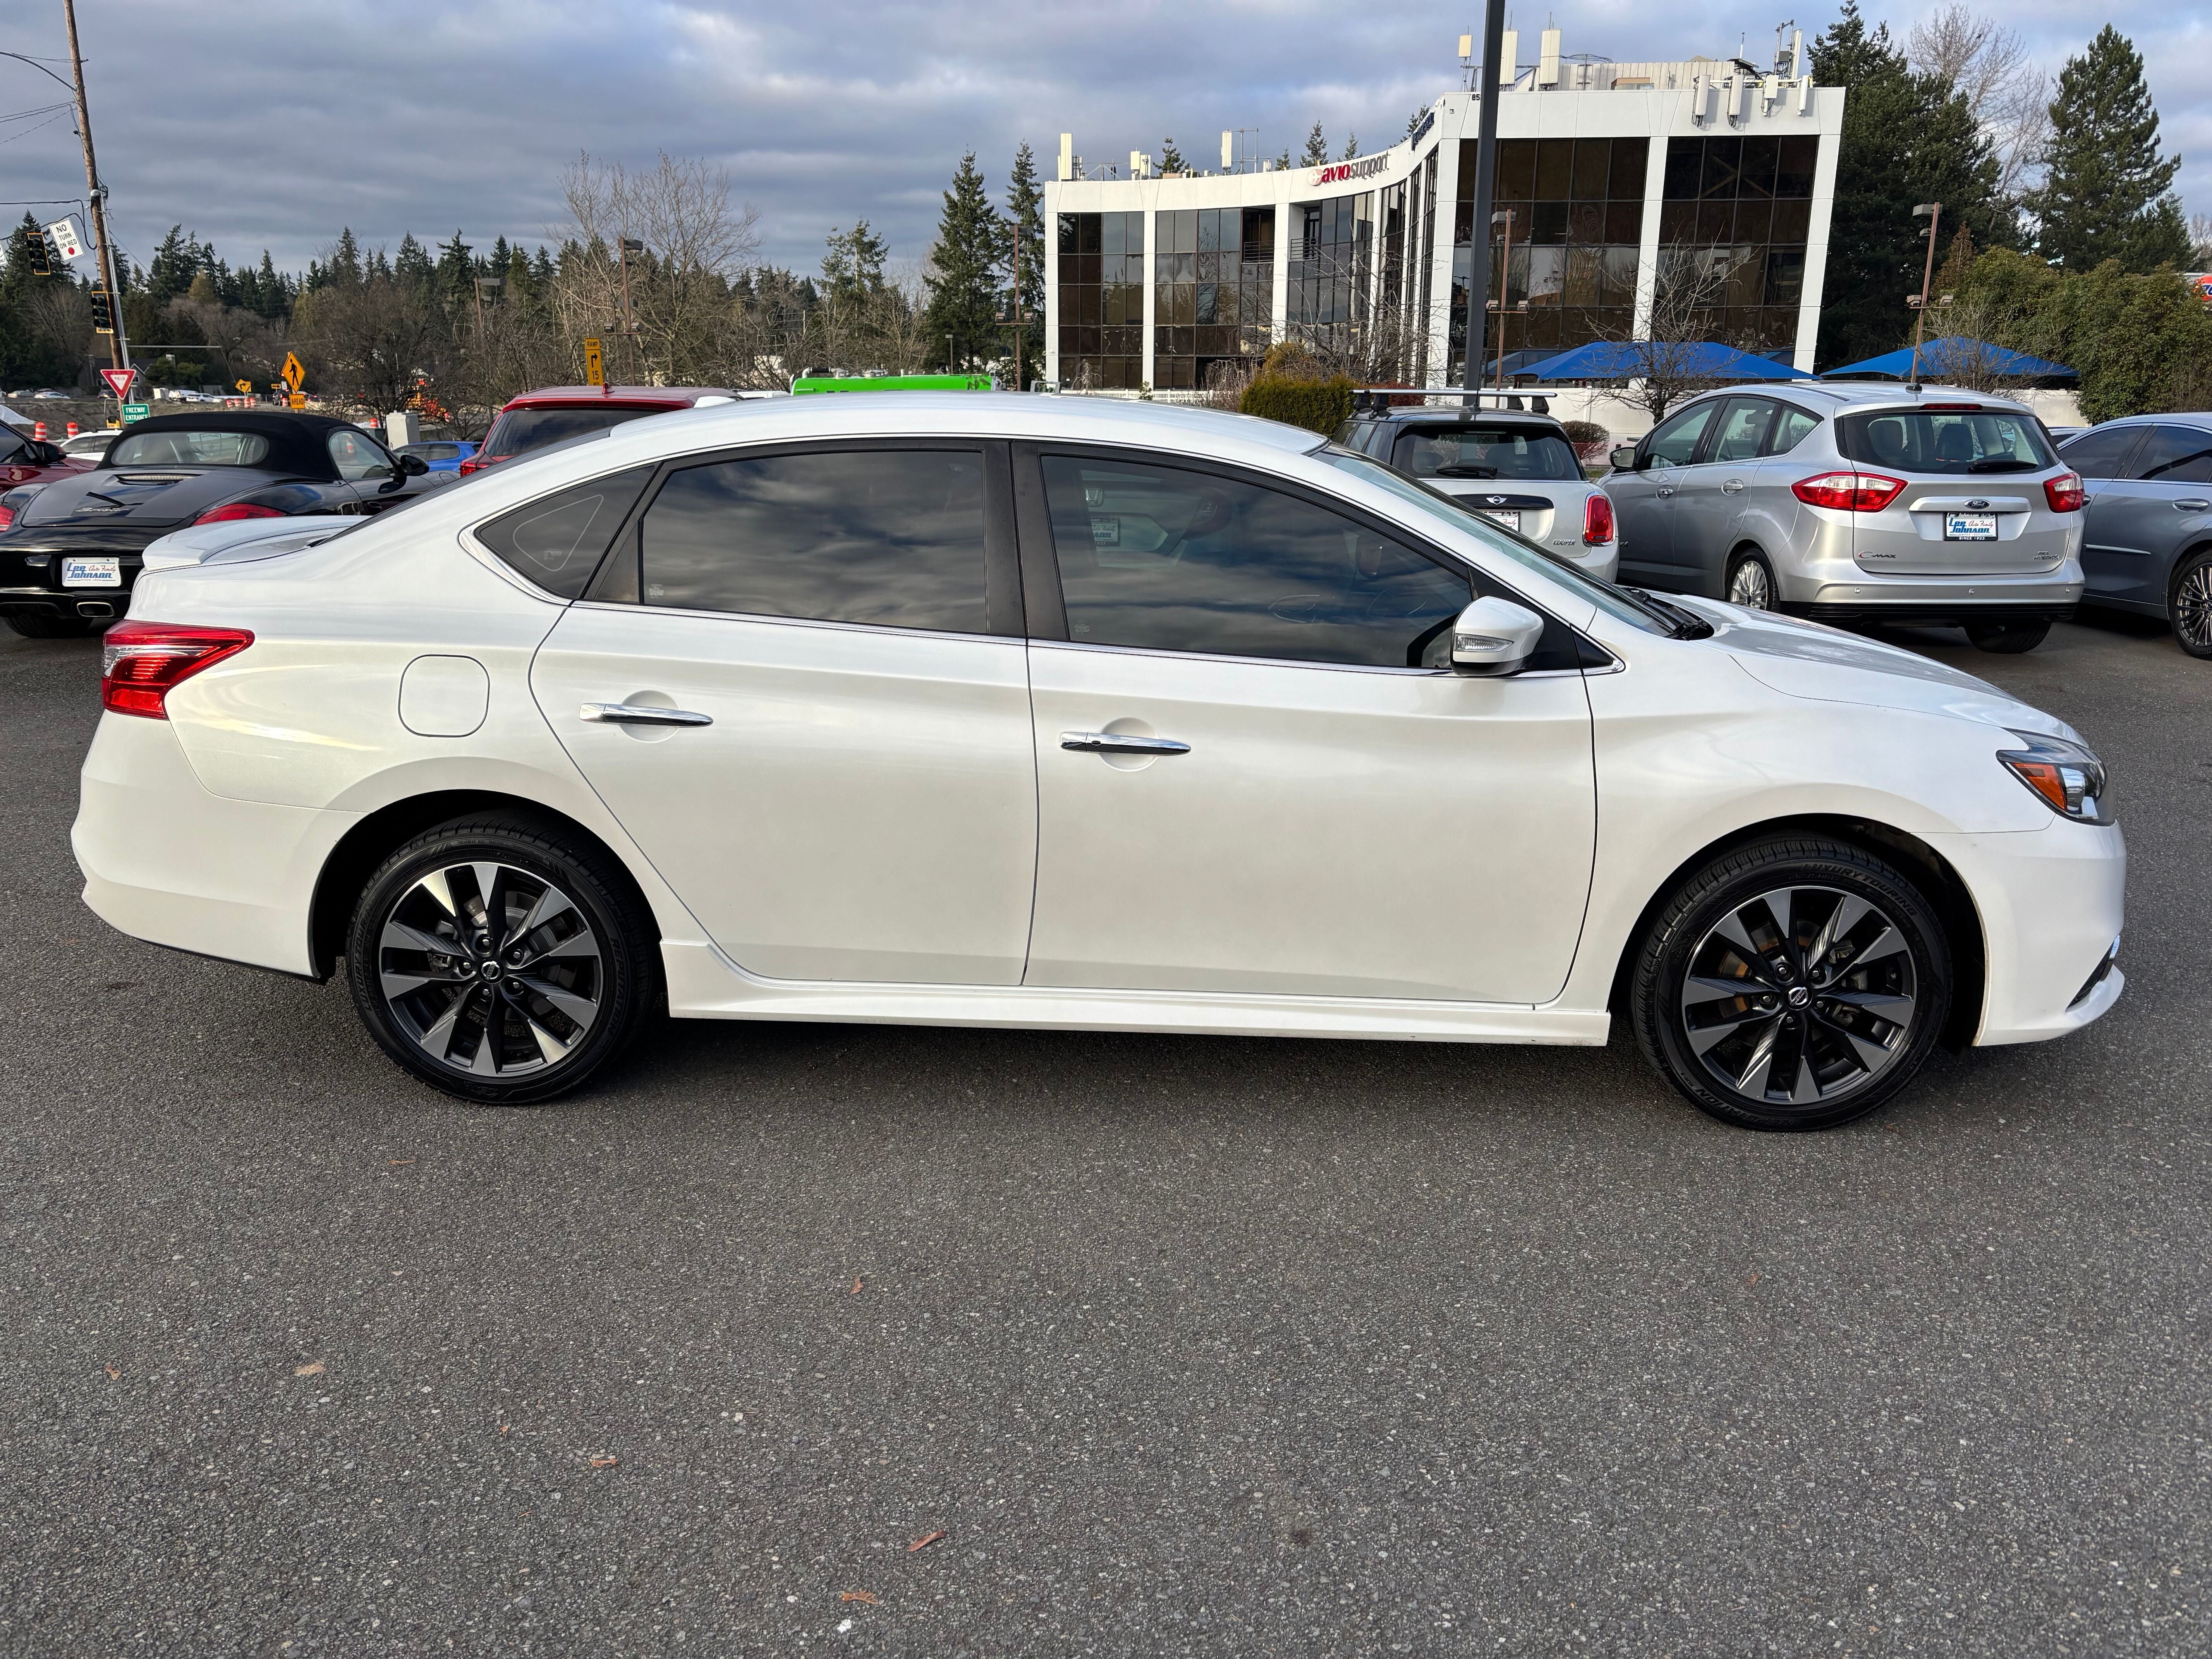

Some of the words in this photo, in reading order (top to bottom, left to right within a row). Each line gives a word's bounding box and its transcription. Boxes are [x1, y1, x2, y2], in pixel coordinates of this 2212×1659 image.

[1321, 151, 1390, 183] aviosupport
[56, 224, 67, 233] NO
[58, 232, 72, 241] TURN
[592, 371, 599, 380] 15
[1949, 518, 1966, 526] Lee
[1949, 524, 1990, 533] Johnson
[67, 562, 87, 571] Lee
[67, 570, 112, 578] Johnson
[1801, 864, 1862, 878] LUXURY
[1862, 874, 1918, 916] TOURING
[354, 956, 373, 1012] LUXURY
